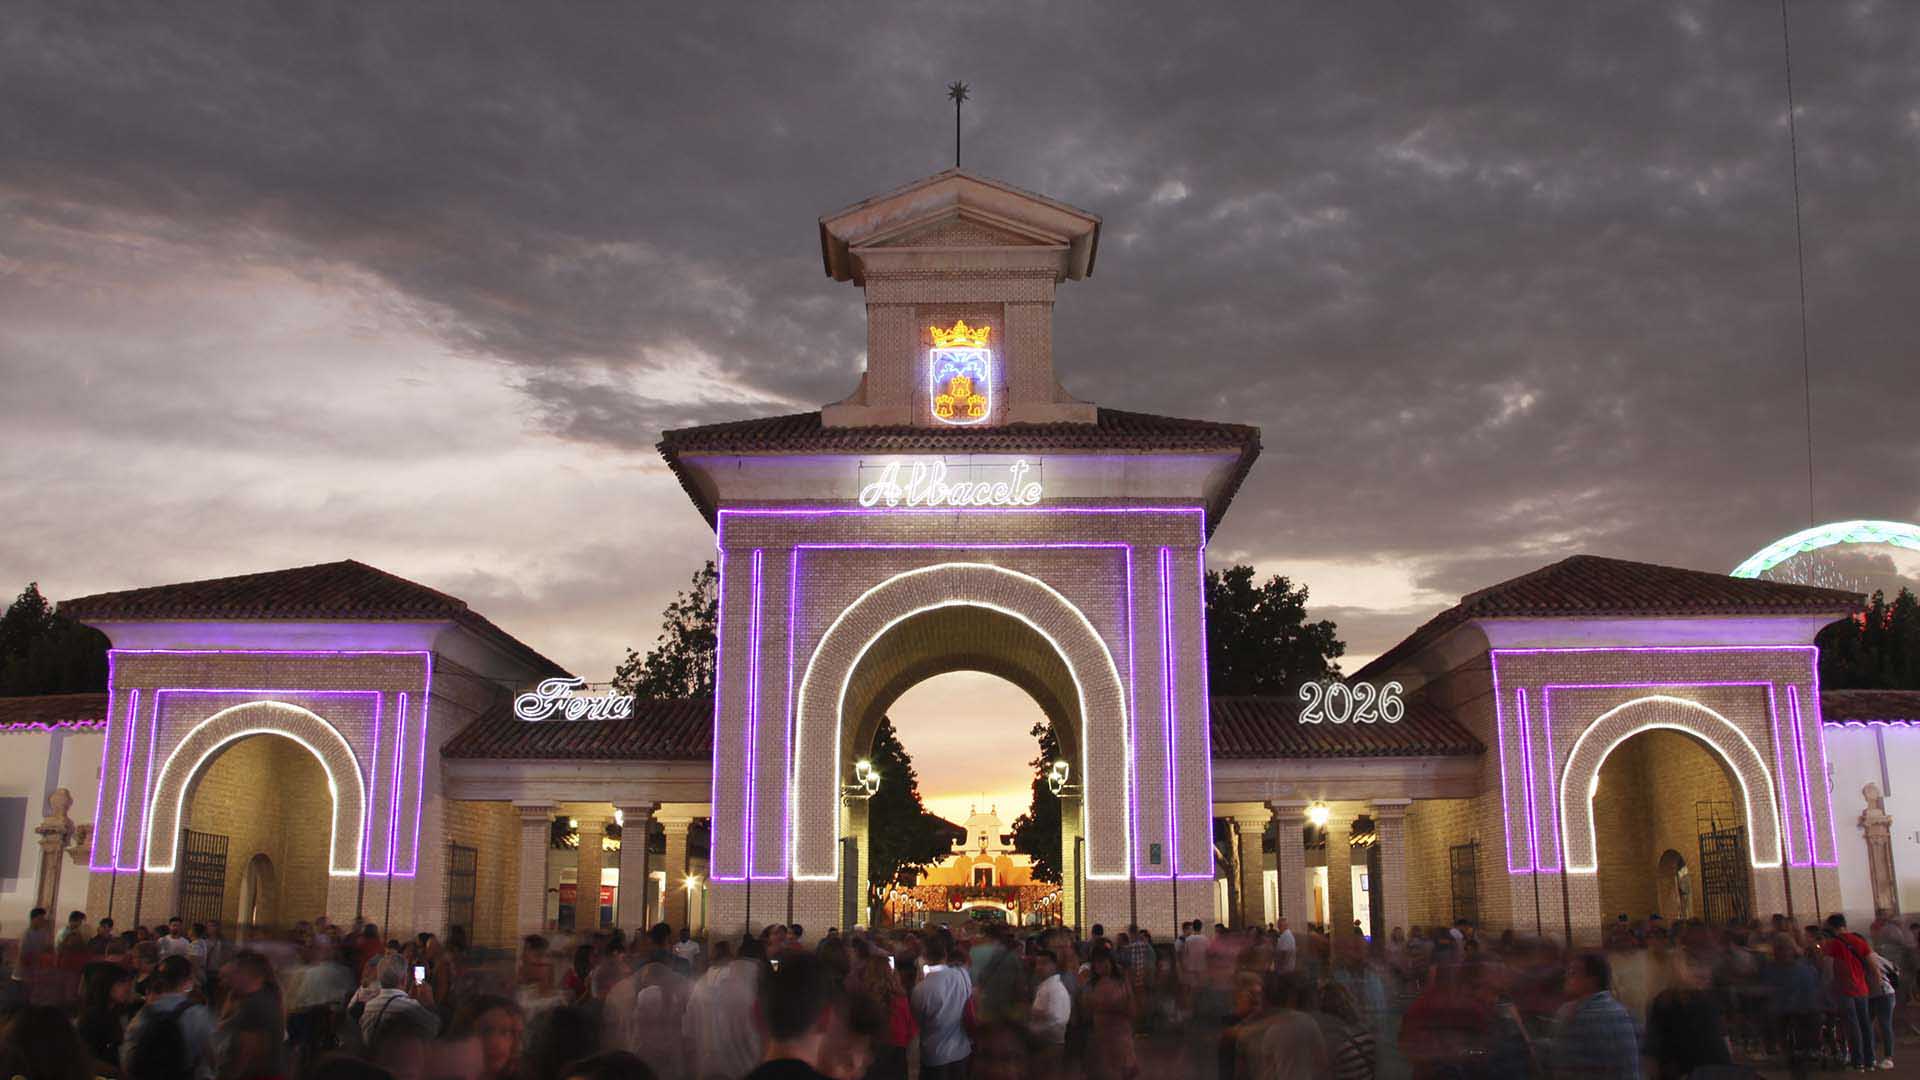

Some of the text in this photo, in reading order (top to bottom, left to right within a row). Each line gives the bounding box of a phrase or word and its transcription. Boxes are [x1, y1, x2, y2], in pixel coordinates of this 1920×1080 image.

[859, 459, 1042, 507] Albacete
[514, 676, 634, 721] Feria
[1299, 681, 1405, 724] 2026
